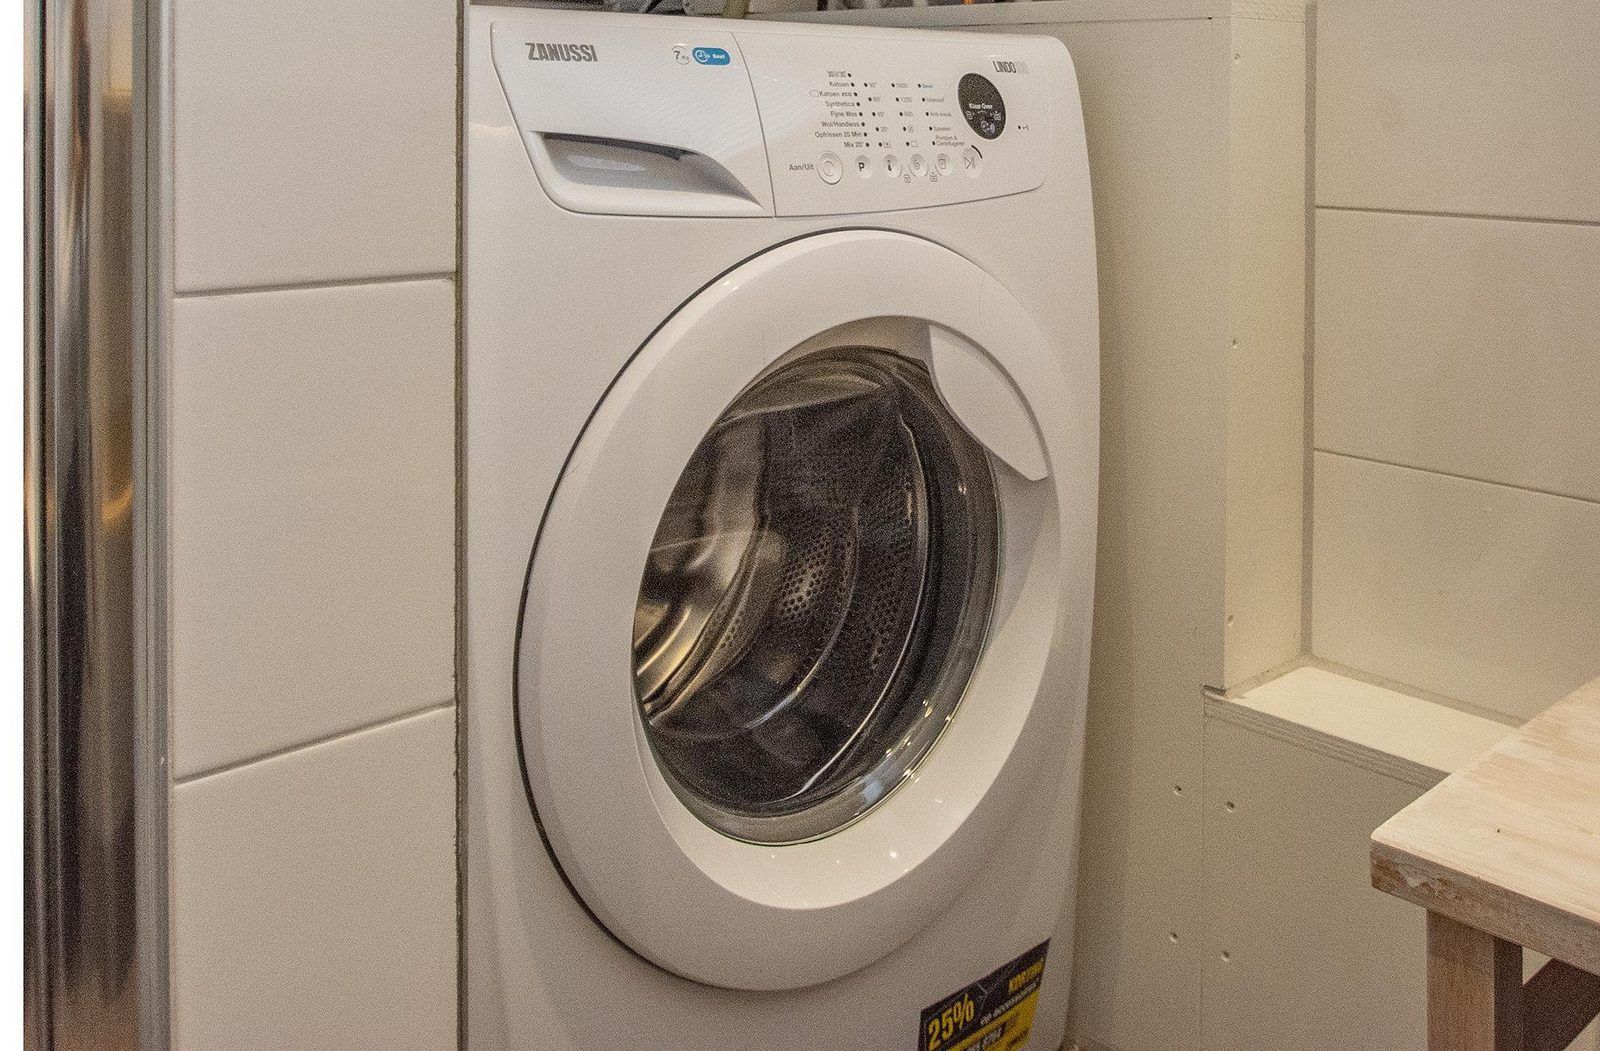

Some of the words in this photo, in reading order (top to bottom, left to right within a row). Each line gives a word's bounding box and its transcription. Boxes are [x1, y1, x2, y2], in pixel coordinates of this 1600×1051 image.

[525, 42, 598, 62] ZANUSSI
[673, 50, 681, 60] 7
[789, 163, 814, 171] Aan/Uit
[858, 162, 865, 172] P
[928, 993, 975, 1051] 25%
